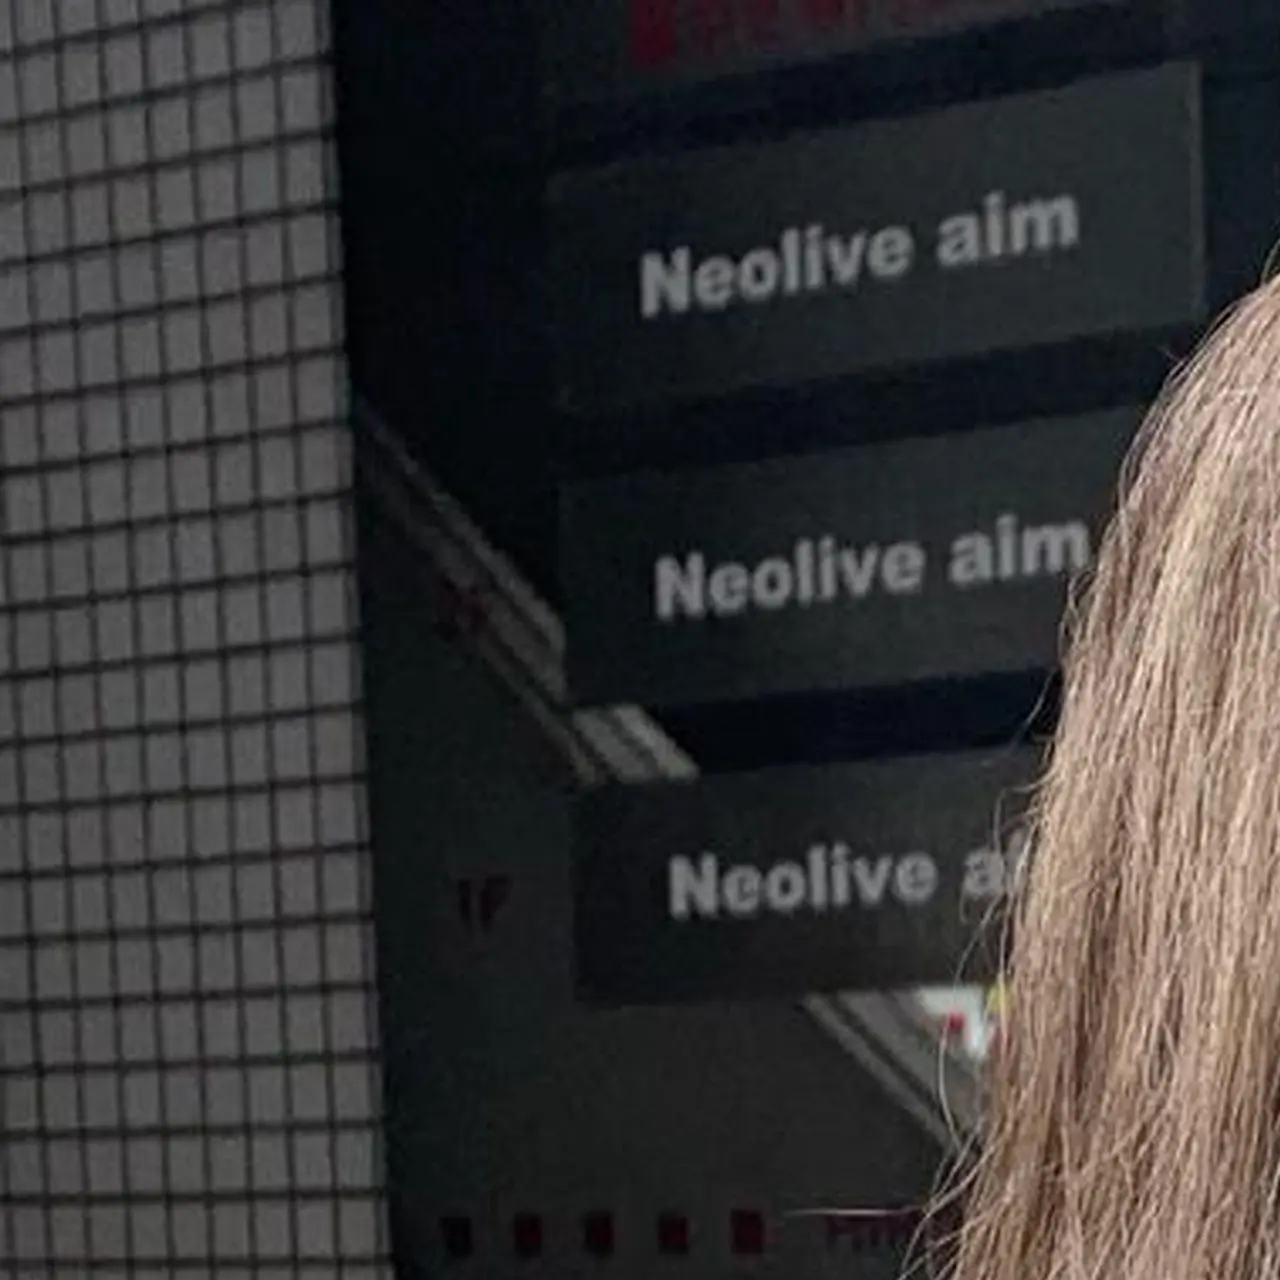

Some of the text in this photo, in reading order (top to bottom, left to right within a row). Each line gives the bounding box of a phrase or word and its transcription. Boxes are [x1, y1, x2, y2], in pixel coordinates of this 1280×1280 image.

[639, 190, 1080, 320] Neolive aim
[653, 513, 1091, 622] Neolive aim
[668, 840, 939, 921] Neolive
